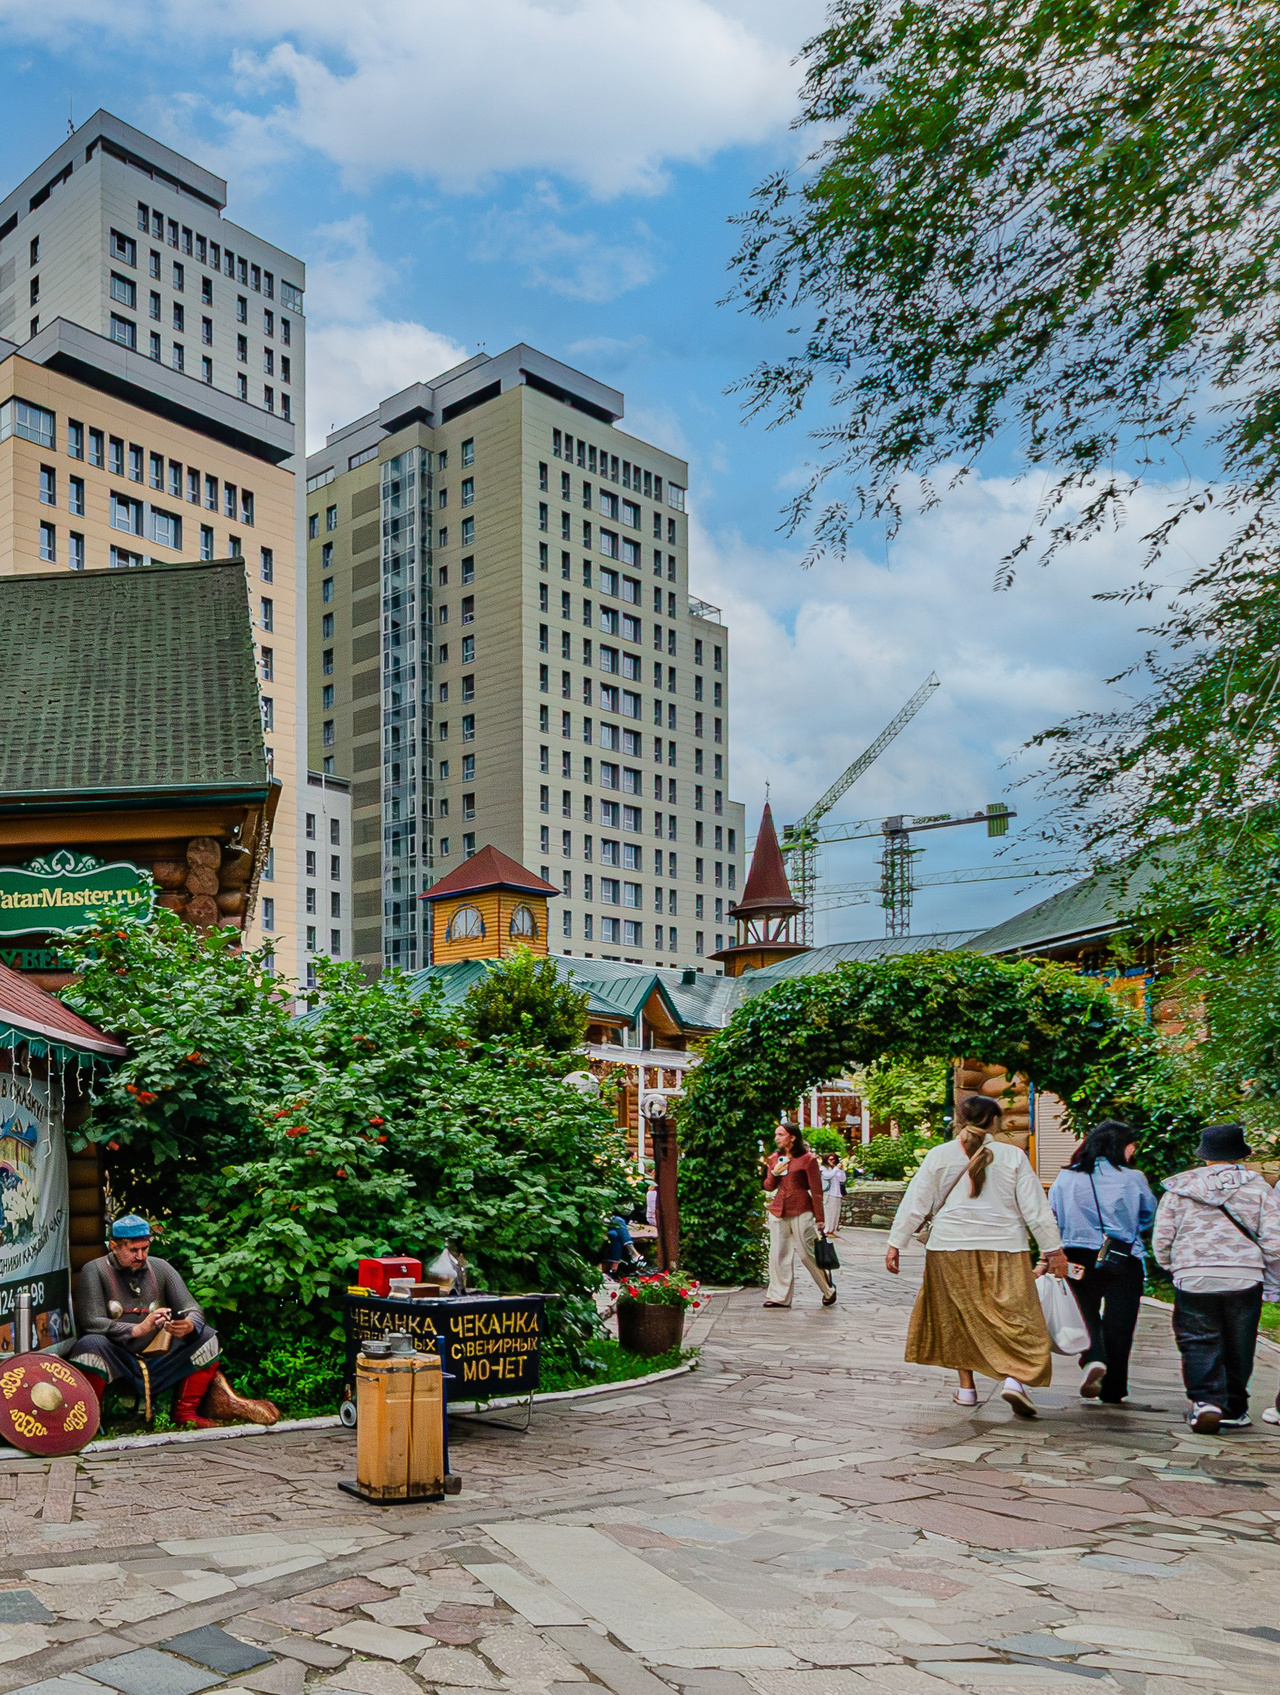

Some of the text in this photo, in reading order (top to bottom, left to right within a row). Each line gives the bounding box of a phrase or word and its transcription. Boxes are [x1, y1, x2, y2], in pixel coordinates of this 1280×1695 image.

[31, 1281, 45, 1306] 98
[350, 1307, 438, 1335] ЧЕКАНКА
[450, 1312, 539, 1338] ЧЕКАНКА
